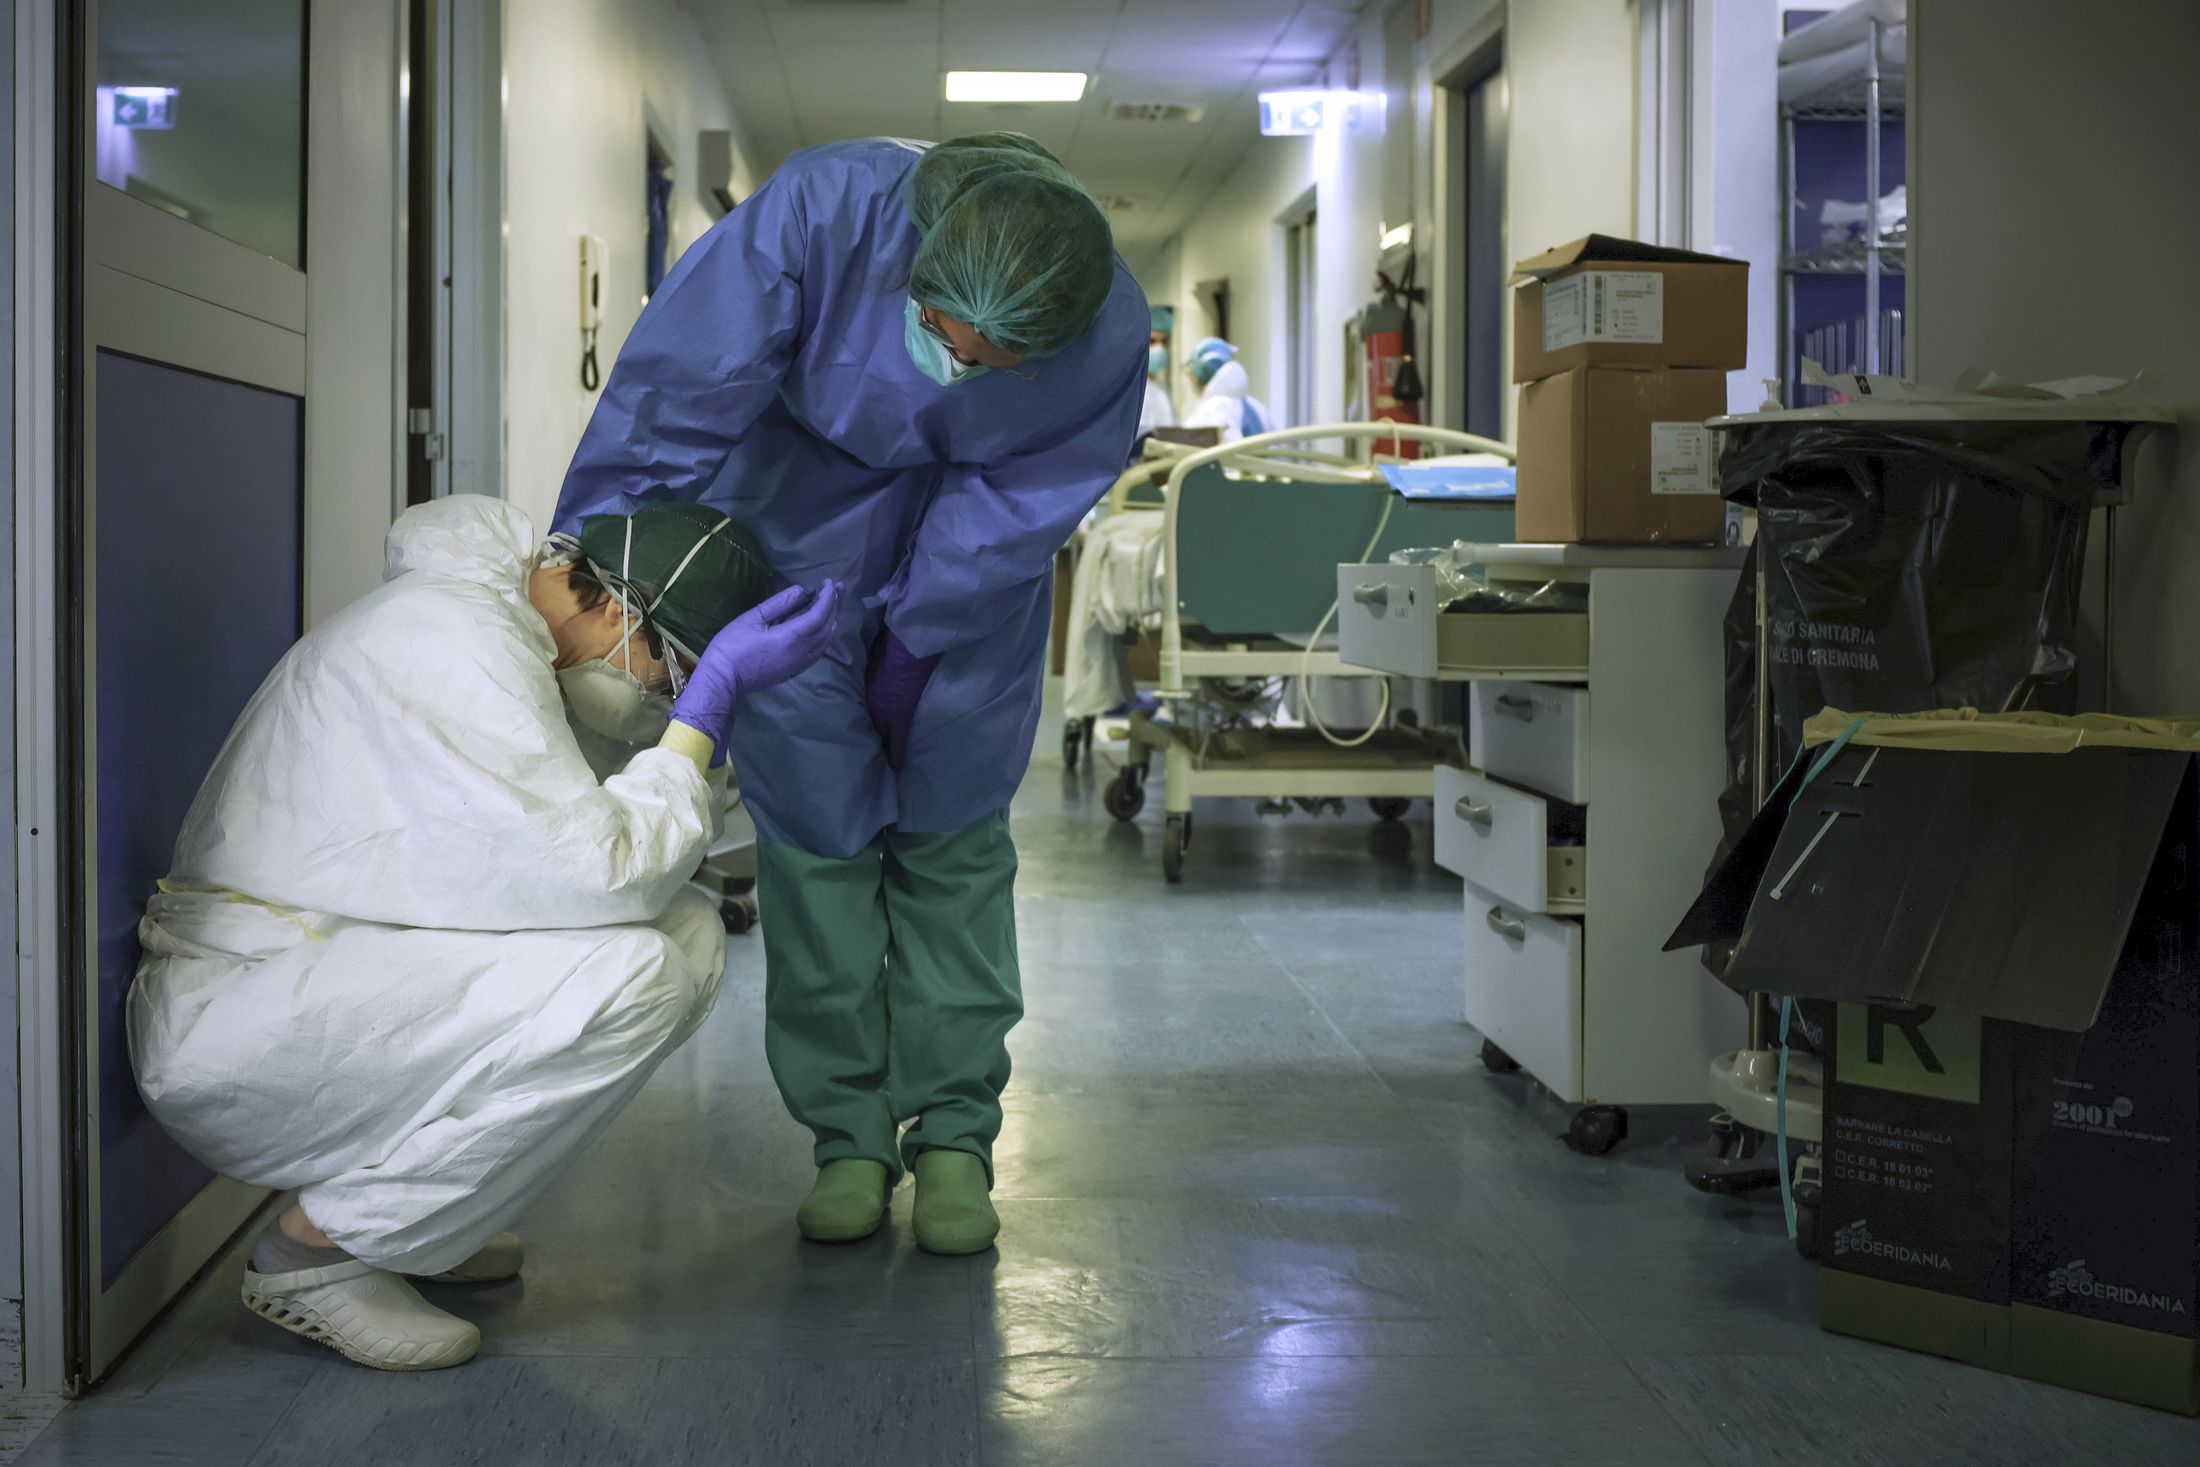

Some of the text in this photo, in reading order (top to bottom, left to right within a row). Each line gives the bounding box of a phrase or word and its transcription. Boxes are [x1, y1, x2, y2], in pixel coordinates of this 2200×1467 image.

[1799, 622, 1876, 646] SANITARIA
[1792, 648, 1803, 665] DI
[1807, 648, 1880, 672] CREMONA
[1867, 1003, 1946, 1075] R
[2053, 1100, 2116, 1128] 2001
[1888, 1125, 1902, 1137] LA
[1867, 1135, 1924, 1154] CORRETTO
[1884, 1160, 1897, 1173] 18
[1899, 1162, 1912, 1176] 01
